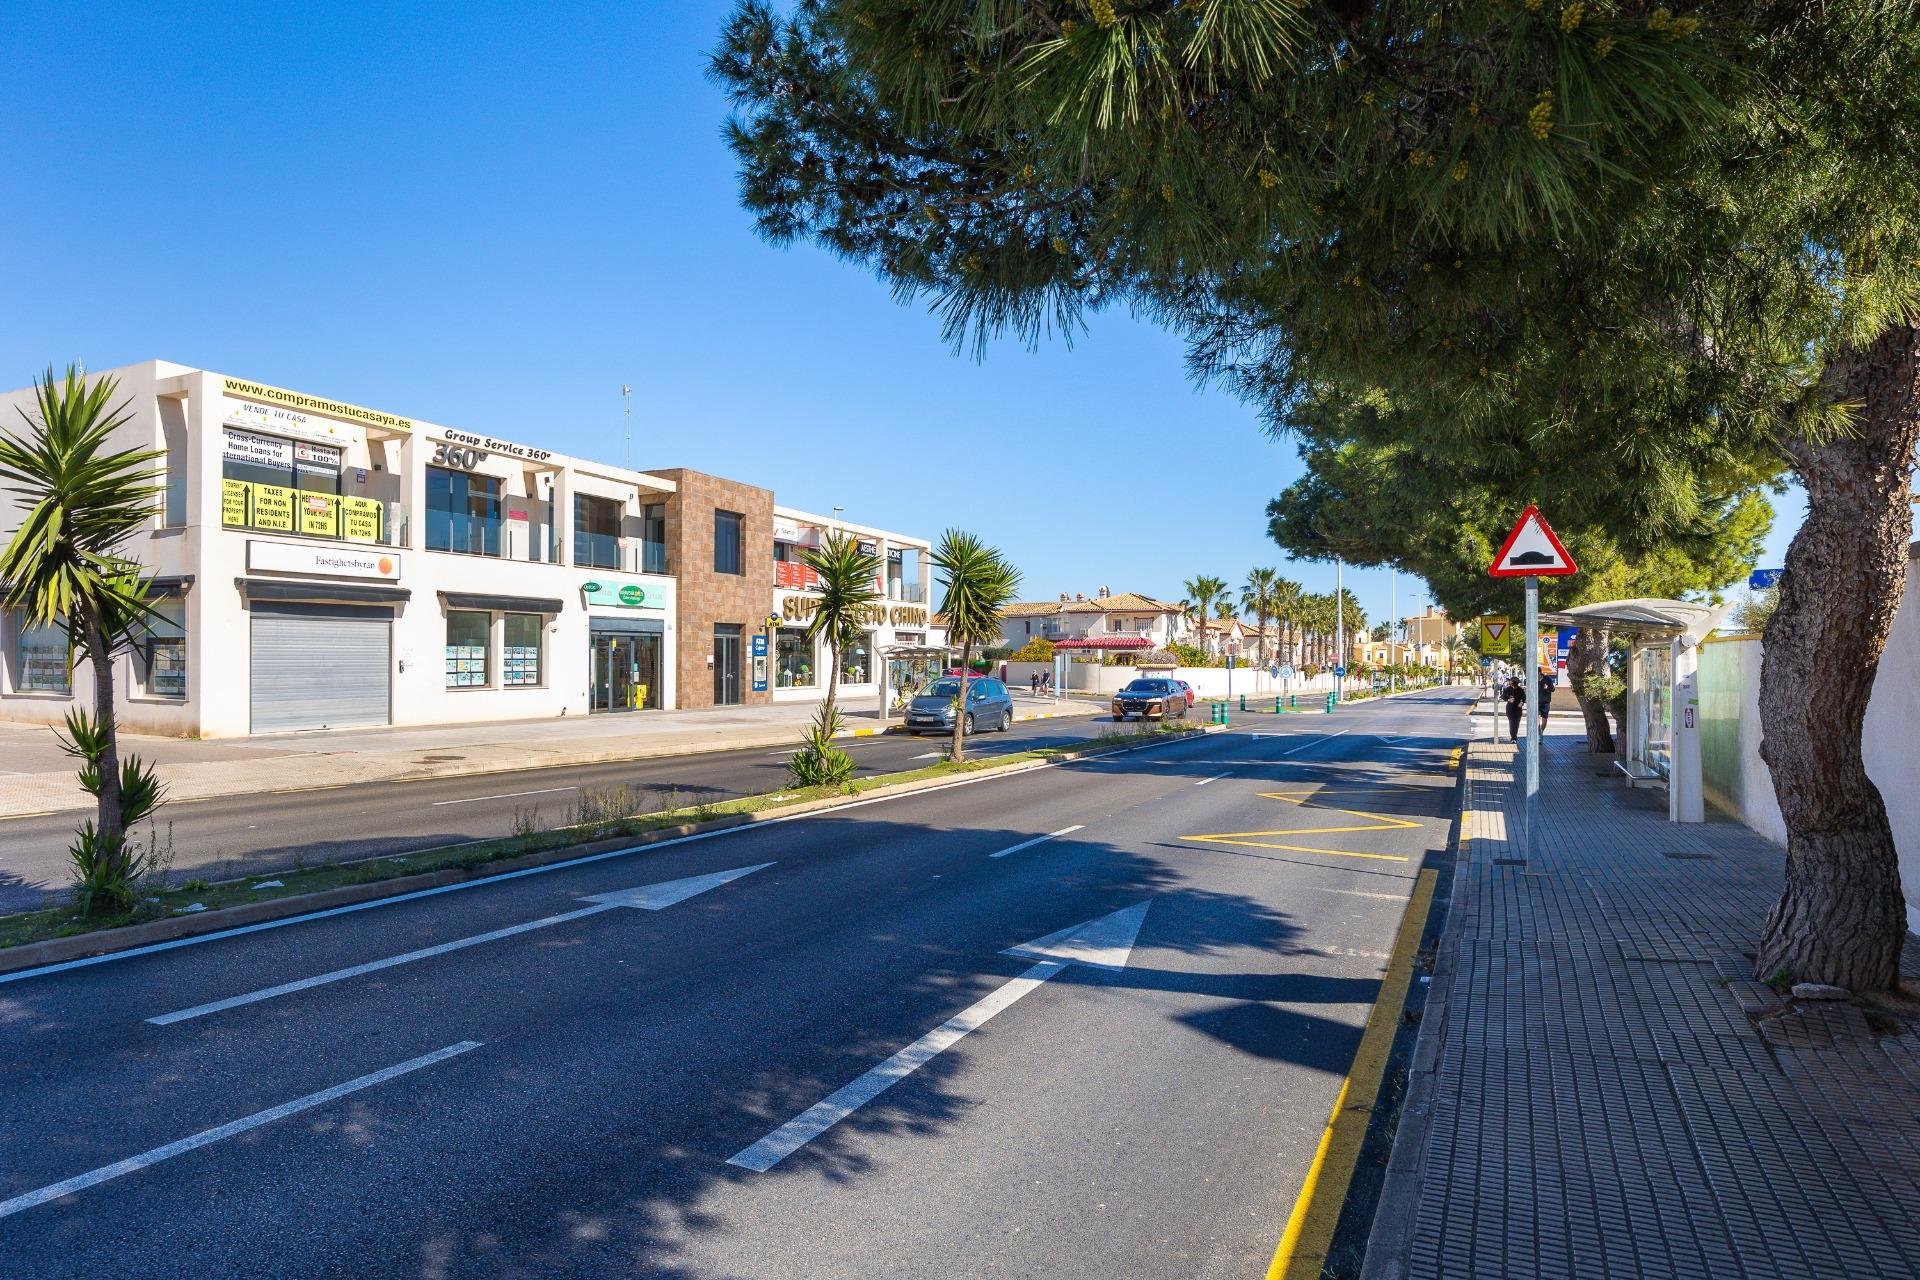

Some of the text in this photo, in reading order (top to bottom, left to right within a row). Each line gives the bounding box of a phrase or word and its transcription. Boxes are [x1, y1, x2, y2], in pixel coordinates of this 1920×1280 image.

[225, 379, 411, 429] www.compramostucasaya.es
[243, 404, 307, 424] VENDE TU CASA
[228, 431, 282, 449] Cross-Currency
[445, 429, 480, 446] Group
[484, 438, 524, 456] Service
[228, 441, 283, 458] Home Loans for
[311, 445, 331, 456] Hasta
[222, 451, 266, 465] nternational
[311, 454, 339, 465] 100%
[263, 487, 283, 497] TAXES
[259, 497, 287, 507] FOR NON
[256, 507, 290, 519] RESIDENTS
[345, 508, 377, 519] COMPRAMOS
[258, 518, 271, 527] AND
[308, 520, 315, 529] IN
[358, 519, 372, 528] CASA
[350, 528, 358, 536] EN
[860, 543, 877, 556] AESTHE
[889, 605, 927, 627] CHINO
